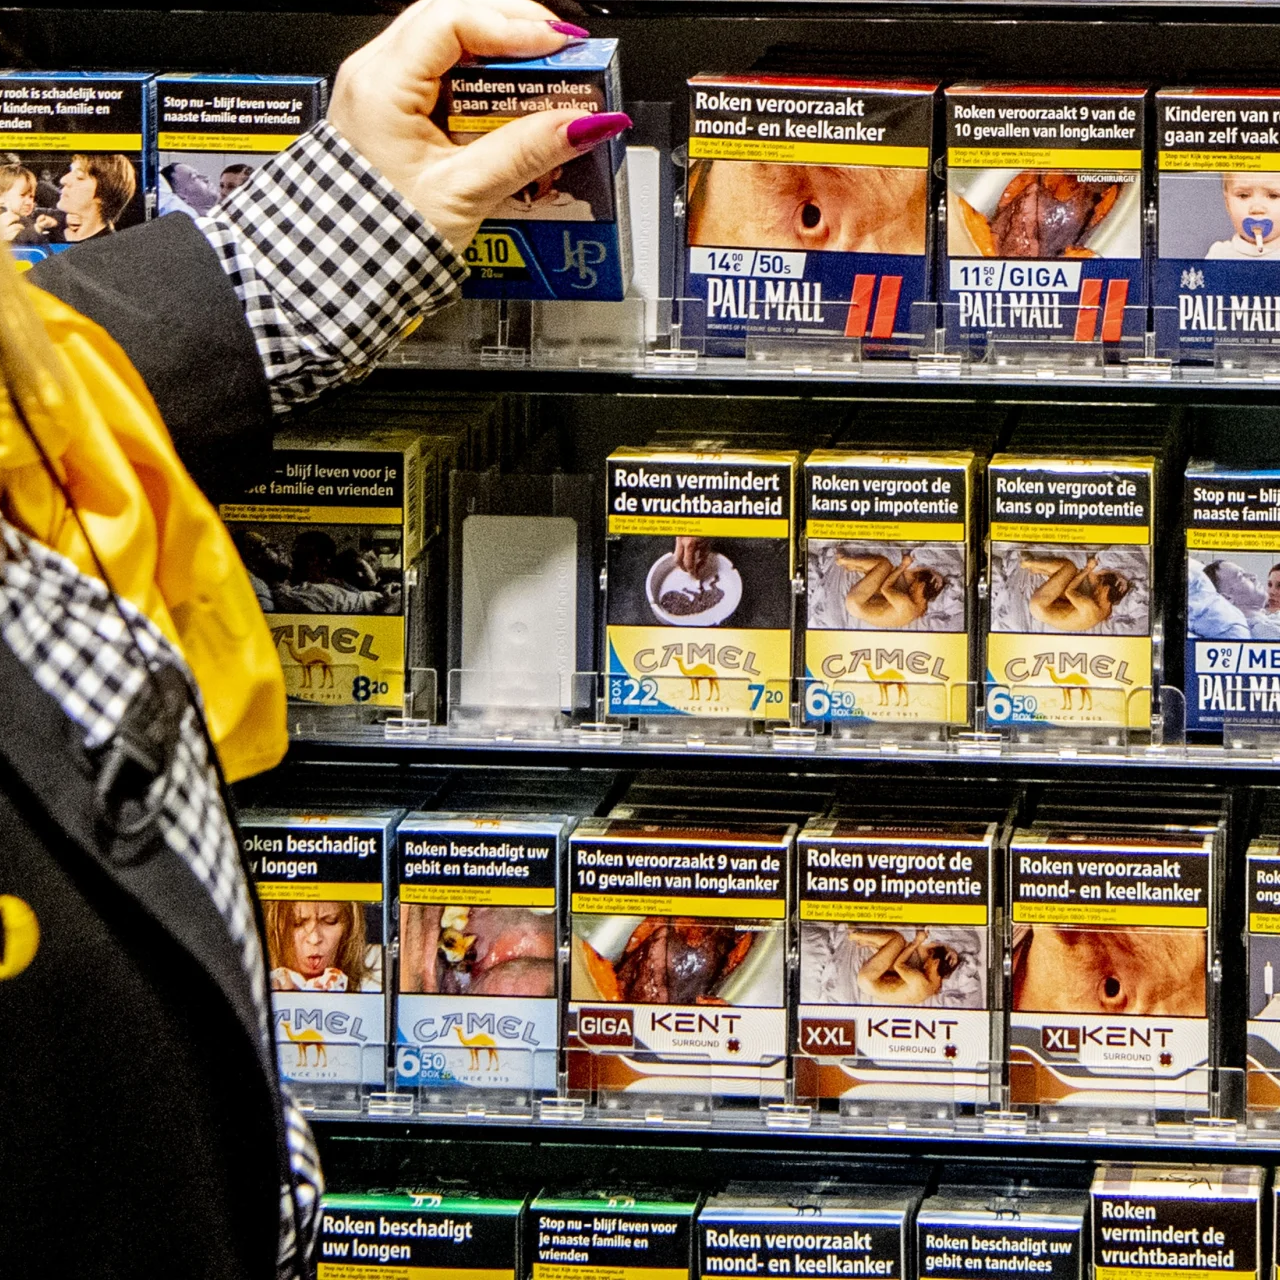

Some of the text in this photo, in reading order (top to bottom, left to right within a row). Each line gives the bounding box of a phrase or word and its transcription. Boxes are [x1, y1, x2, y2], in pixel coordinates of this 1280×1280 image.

[4, 88, 29, 99] rook
[32, 88, 40, 99] is
[42, 88, 96, 103] schadelijk
[98, 91, 123, 100] voor
[451, 79, 592, 96] Kinderen van rokers
[954, 105, 1136, 120] Roken veroorzaakt 9 van de
[955, 123, 1135, 141] 10 gevallen van longkanker
[1076, 173, 1135, 183] LONGCHIRURGIE
[1009, 267, 1065, 287] GIGA
[707, 278, 823, 322] PALL MALL
[616, 468, 779, 490] Roken vermindert
[615, 494, 782, 517] de vruchtbaarheid
[1194, 488, 1224, 505] Stop
[1228, 492, 1245, 502] nu
[1194, 508, 1239, 521] naaste
[634, 642, 762, 675] CAMEL
[612, 678, 623, 706] BOX
[624, 677, 660, 707] 22
[580, 1012, 632, 1038] GIGA
[650, 1011, 742, 1035] KENT
[671, 1038, 720, 1049] SURROUND
[805, 1025, 854, 1048] XXL
[1102, 1201, 1155, 1219] Roken
[706, 1229, 872, 1250] Roken veroorzaakt
[1102, 1226, 1224, 1244] vermindert de
[706, 1253, 894, 1276] mond- en keelkanker
[1102, 1245, 1234, 1269] vruchtbaarheid
